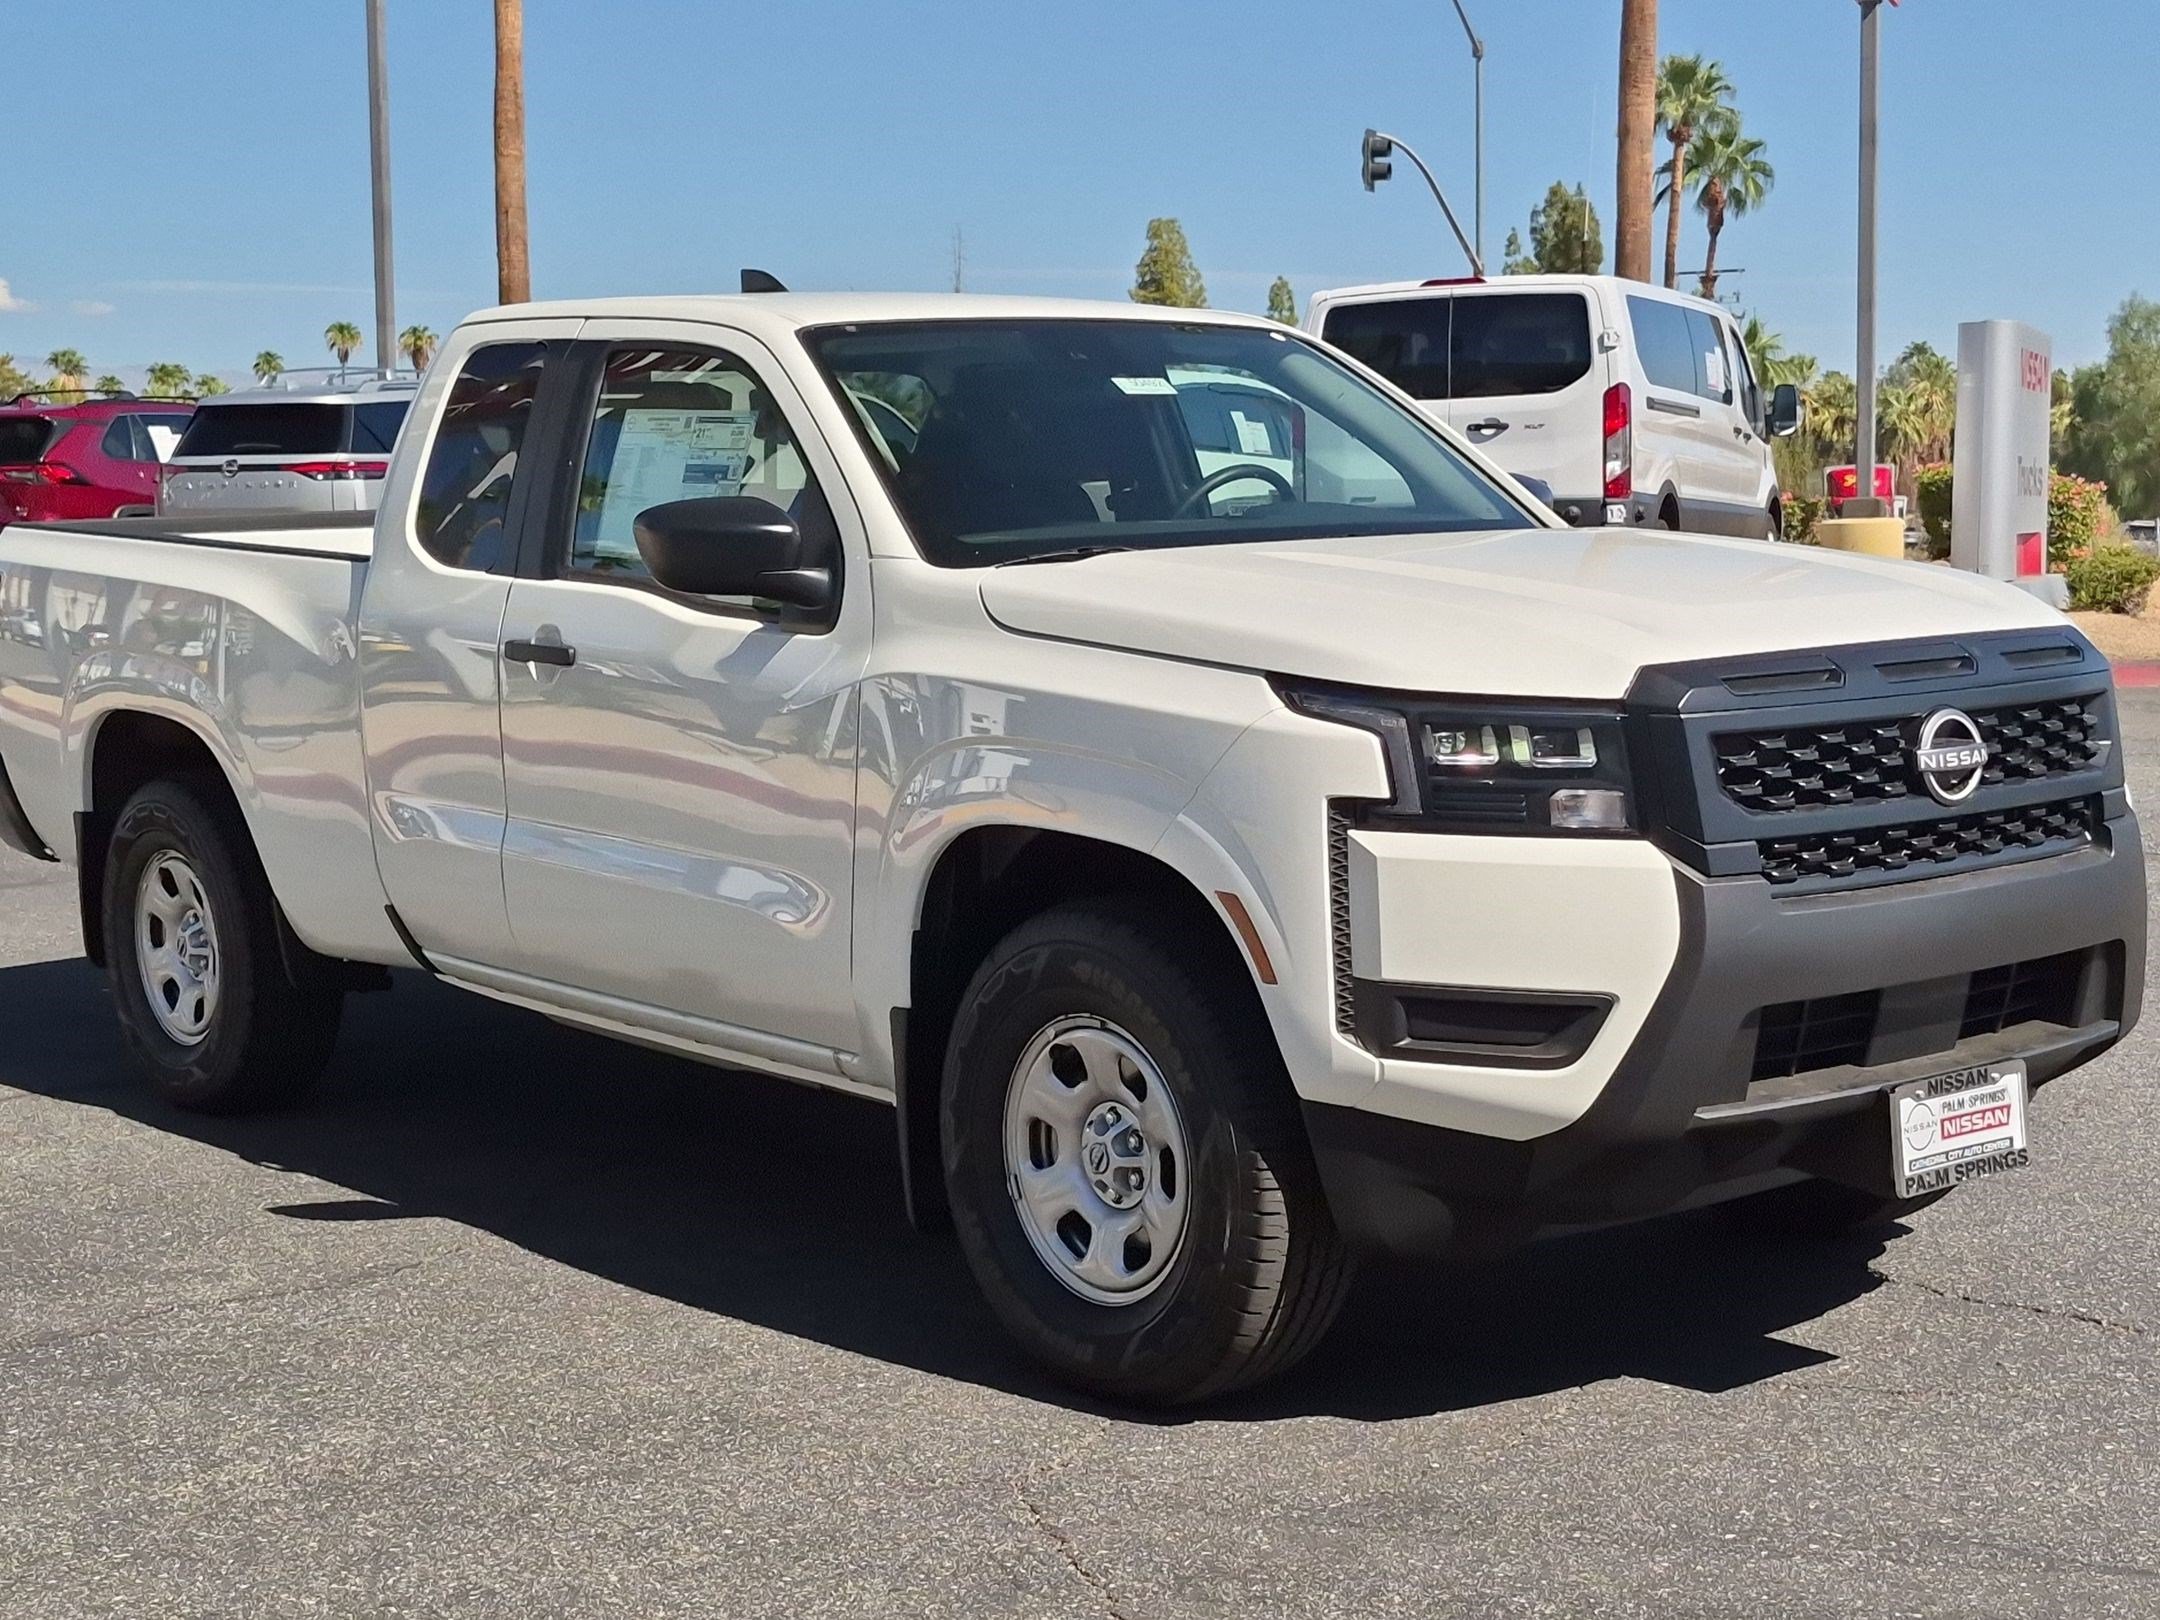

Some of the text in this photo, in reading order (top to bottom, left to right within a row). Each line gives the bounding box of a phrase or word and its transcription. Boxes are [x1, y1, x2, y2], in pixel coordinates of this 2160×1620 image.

[2017, 455, 2044, 497] Trucks
[1920, 748, 1988, 769] NISSAN
[1927, 1067, 1989, 1097] NISSAN
[1941, 1088, 2007, 1114] PALM SPRINGS
[1903, 1119, 1938, 1135] NISSAN
[1942, 1106, 2010, 1137] NISSAN
[1904, 1149, 2029, 1196] PALM SPRINGS
